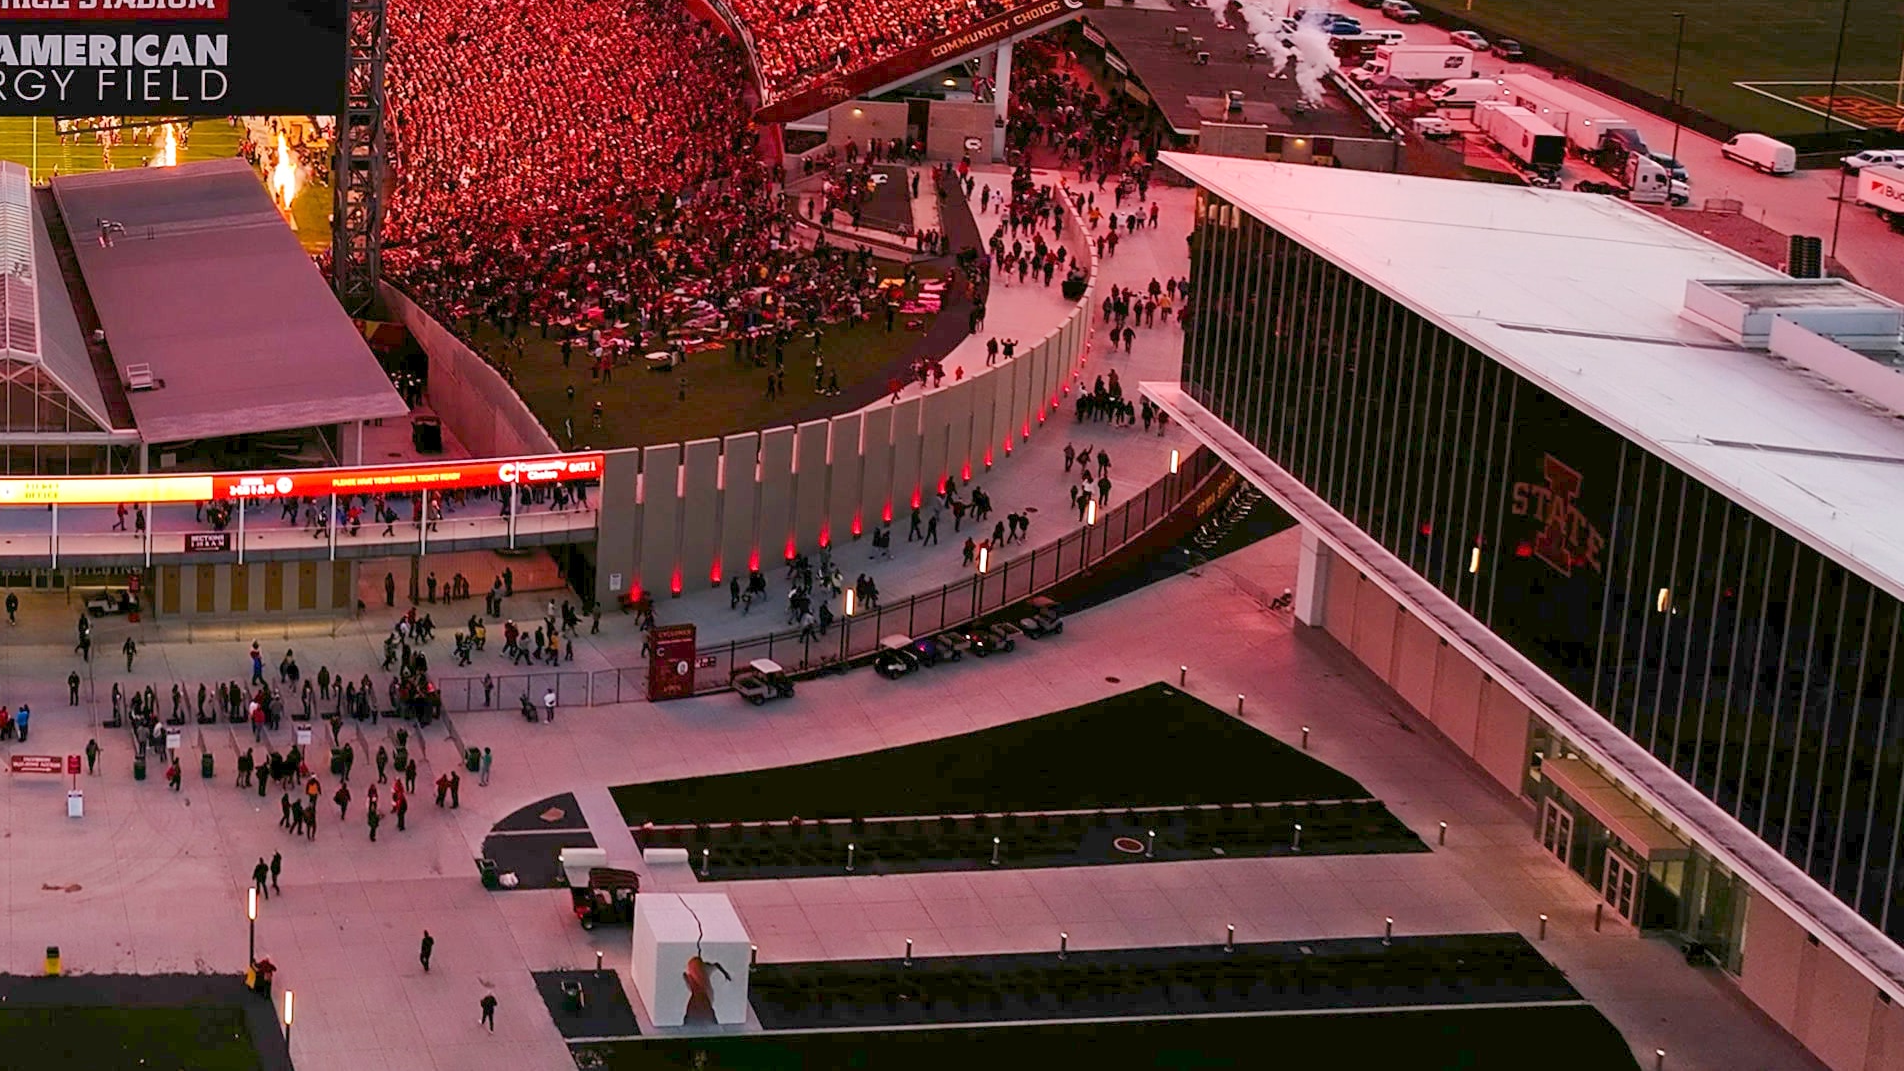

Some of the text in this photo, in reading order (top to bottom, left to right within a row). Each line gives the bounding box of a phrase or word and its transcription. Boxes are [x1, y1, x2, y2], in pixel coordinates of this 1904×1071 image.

[930, 19, 1010, 58] COMMUNITY
[1013, 0, 1061, 26] CHOICE
[98, 69, 228, 101] FIELD
[1512, 481, 1605, 573] STATE
